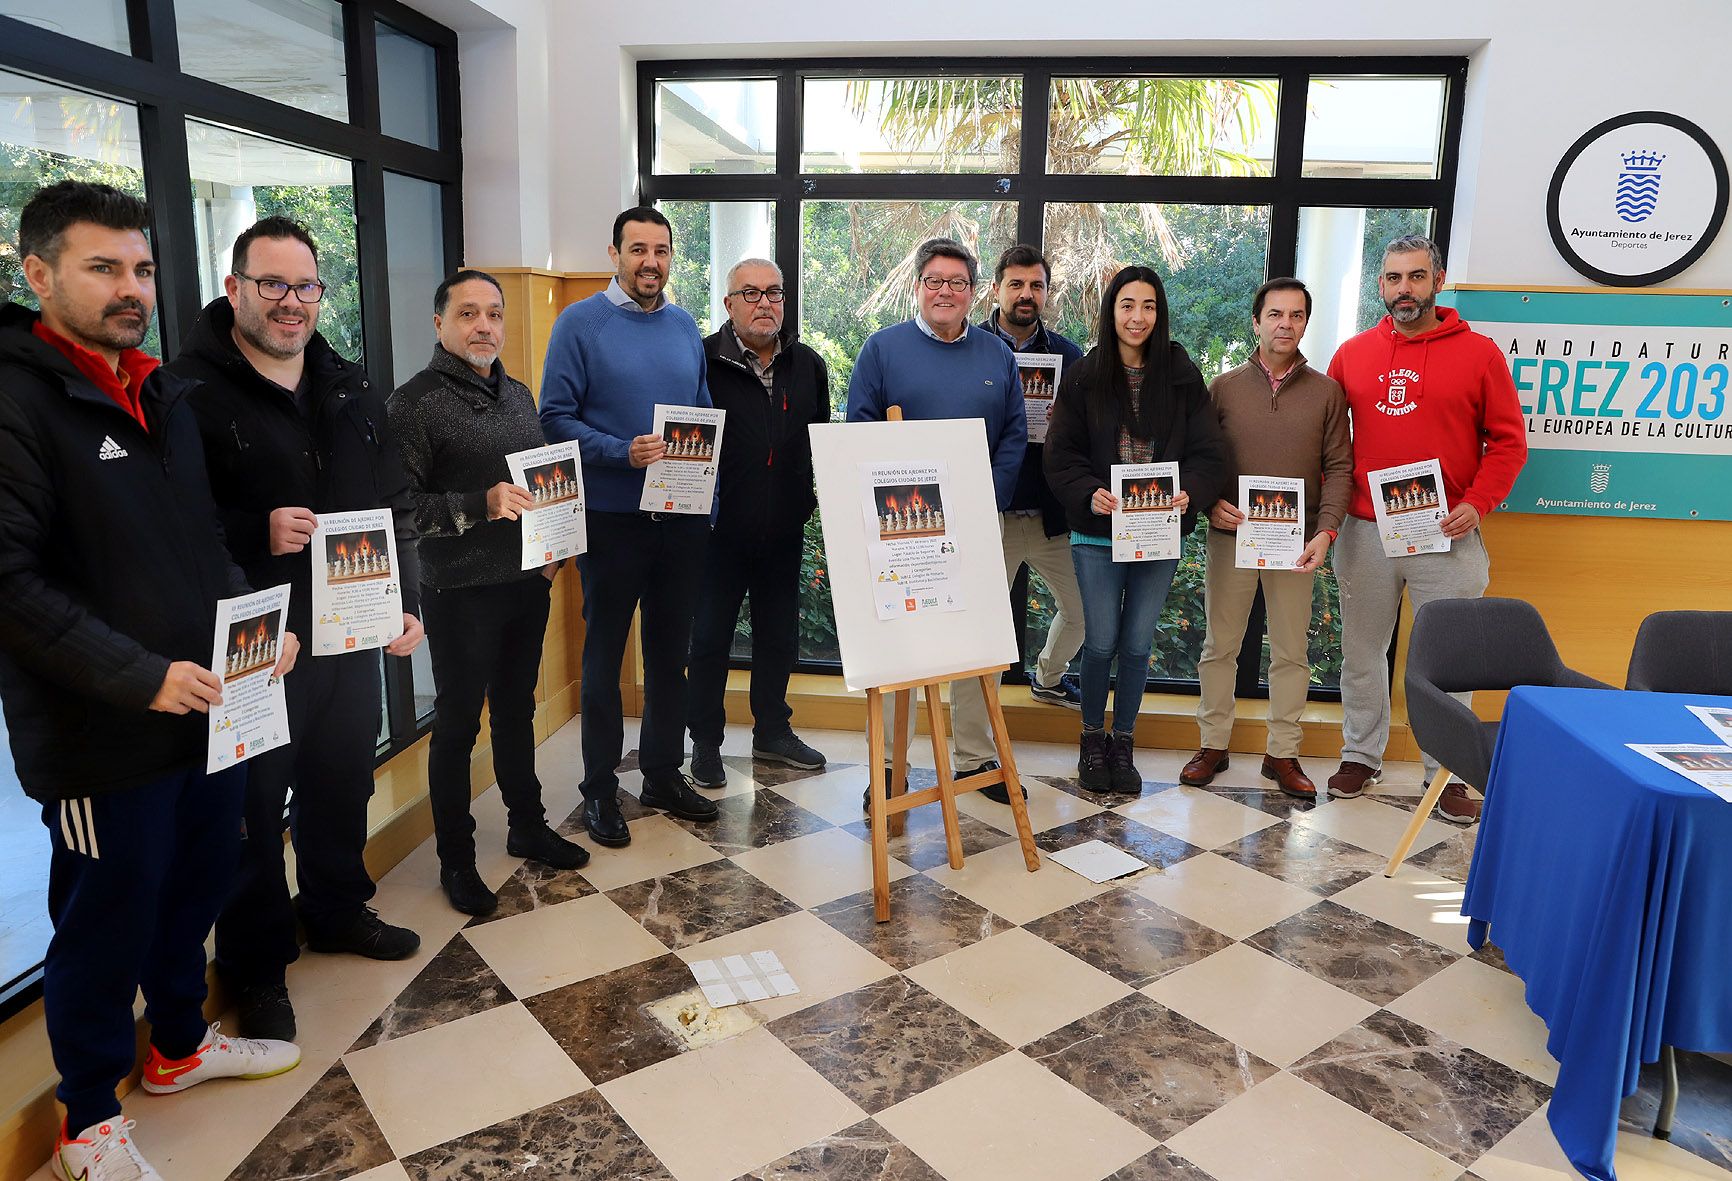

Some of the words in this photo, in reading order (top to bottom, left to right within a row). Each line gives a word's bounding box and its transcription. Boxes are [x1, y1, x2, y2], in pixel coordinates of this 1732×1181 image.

[1570, 228, 1646, 239] Ayuntamiento
[1650, 231, 1662, 239] de
[1664, 232, 1692, 241] Jerez
[1611, 240, 1648, 249] Deportes
[1489, 338, 1729, 360] ANDIDATUR
[1512, 358, 1630, 417] EREZ
[1375, 401, 1387, 413] LA
[1544, 419, 1613, 435] EUROPEA
[1621, 422, 1640, 436] DE
[1647, 422, 1666, 437] LA
[99, 449, 128, 460] adidas
[1536, 498, 1611, 510] Ayuntamiento
[1614, 500, 1627, 509] de
[1629, 501, 1657, 511] Jerez
